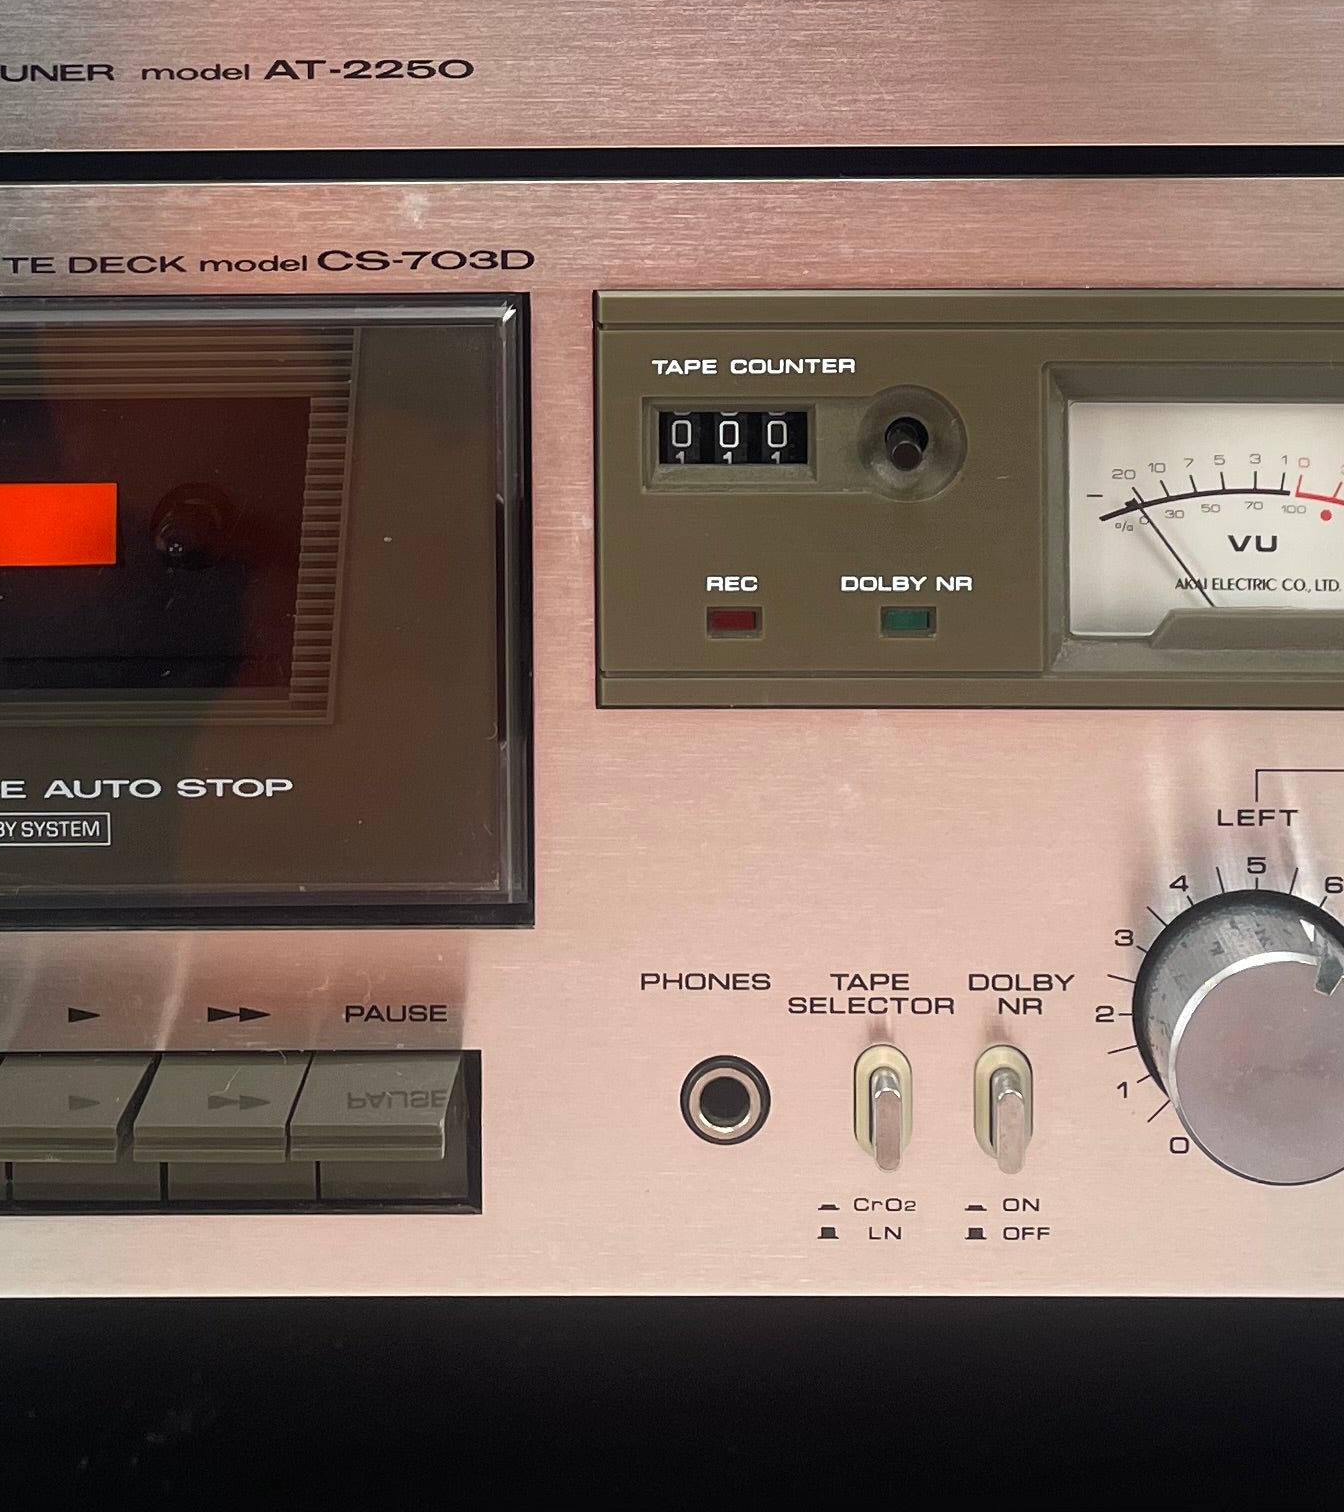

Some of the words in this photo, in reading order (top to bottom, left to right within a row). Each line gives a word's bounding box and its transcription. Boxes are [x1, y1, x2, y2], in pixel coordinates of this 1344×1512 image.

[141, 63, 250, 81] model
[263, 59, 475, 81] AT-2250
[68, 255, 187, 274] DECK
[199, 254, 308, 273] model
[317, 249, 535, 272] CS-703D
[651, 359, 718, 376] TAPE
[730, 358, 856, 375] COUNTER
[1227, 534, 1278, 553] VU
[706, 576, 758, 592] REC
[840, 575, 928, 592] DOLBY
[936, 576, 973, 592] NR
[1174, 577, 1208, 593] AKAI
[1211, 577, 1278, 592] ELECTRIC
[1281, 577, 1312, 594] CO.,
[1314, 578, 1340, 592] LTD.
[43, 778, 162, 799] AUTO
[176, 778, 294, 798] STOP
[1217, 808, 1299, 827] LEFT
[21, 820, 100, 838] SYSTEM
[1246, 856, 1267, 875] 5
[1168, 874, 1190, 893] 4
[1324, 876, 1344, 894] 6
[1114, 929, 1134, 947] 3
[640, 972, 772, 991] PHONES
[829, 973, 910, 992] TAPE
[968, 973, 1075, 992] DOLBY
[345, 1004, 448, 1024] PAUSE
[788, 996, 955, 1015] SELECTOR
[998, 997, 1043, 1016] NR
[1095, 1005, 1115, 1023] 2
[1169, 1136, 1190, 1154] 0
[1002, 1197, 1040, 1212] ON
[868, 1226, 902, 1241] LN
[1002, 1226, 1051, 1241] OFF
